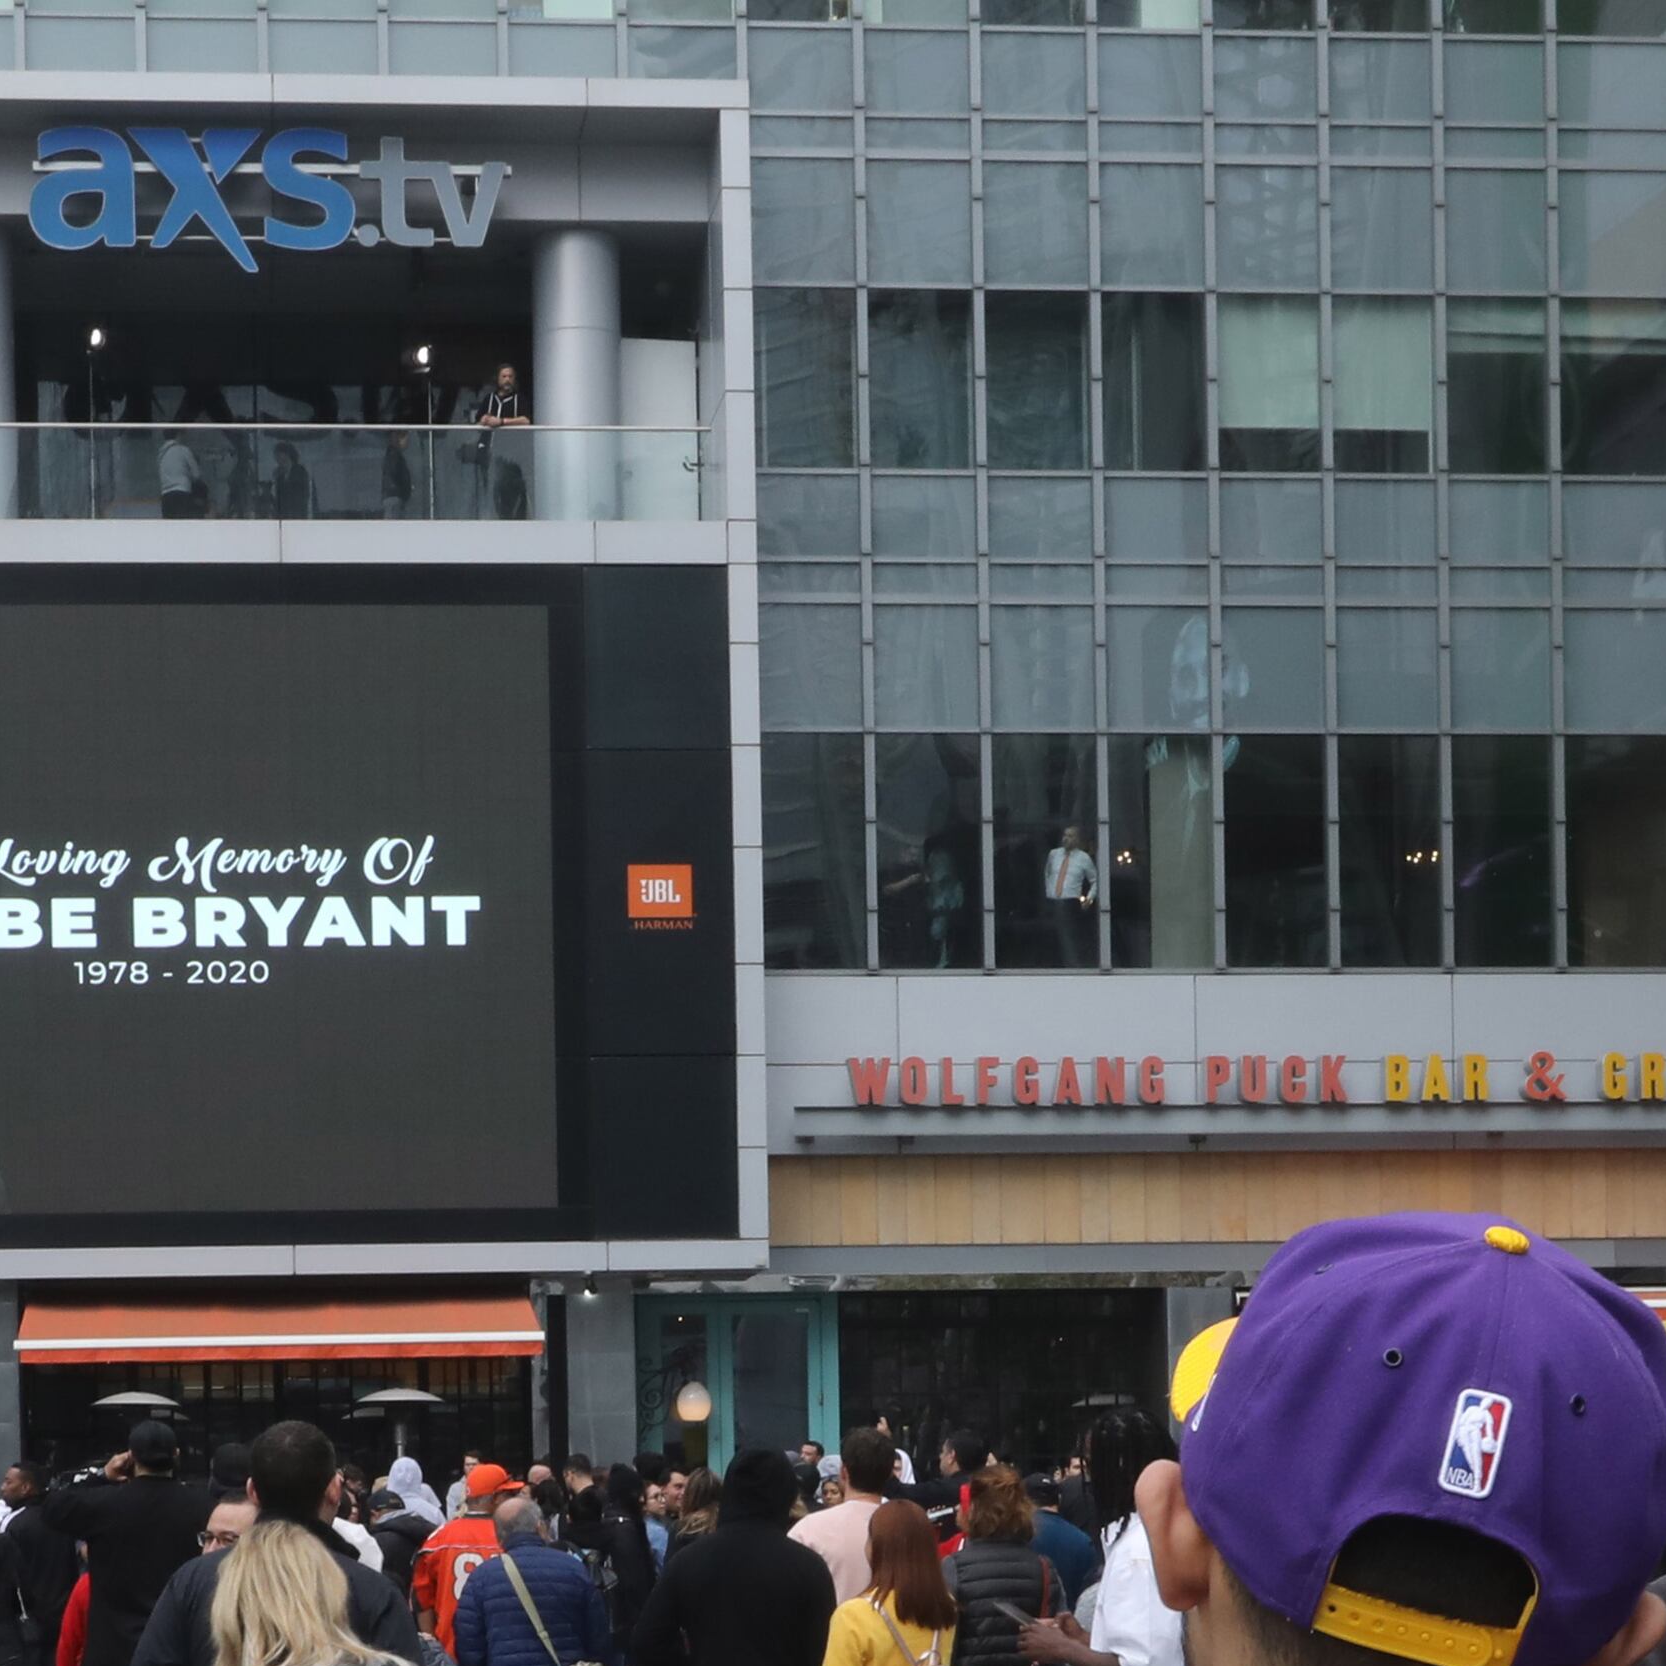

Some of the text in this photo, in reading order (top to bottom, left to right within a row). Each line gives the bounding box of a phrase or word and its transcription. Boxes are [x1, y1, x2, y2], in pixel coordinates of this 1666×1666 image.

[29, 125, 508, 273] axs.tv
[147, 836, 348, 894] Memory
[363, 834, 436, 887] Of
[640, 879, 681, 903] JBL
[132, 894, 481, 948] BRYANT
[634, 919, 693, 930] HARMAN
[73, 960, 149, 985] 1978
[186, 960, 270, 984] 2020
[847, 1056, 1165, 1106] WOLFGANG
[1204, 1055, 1347, 1103] PUCK
[1383, 1054, 1490, 1102] BAR
[1524, 1051, 1566, 1101] &
[1445, 1466, 1475, 1490] NBA
